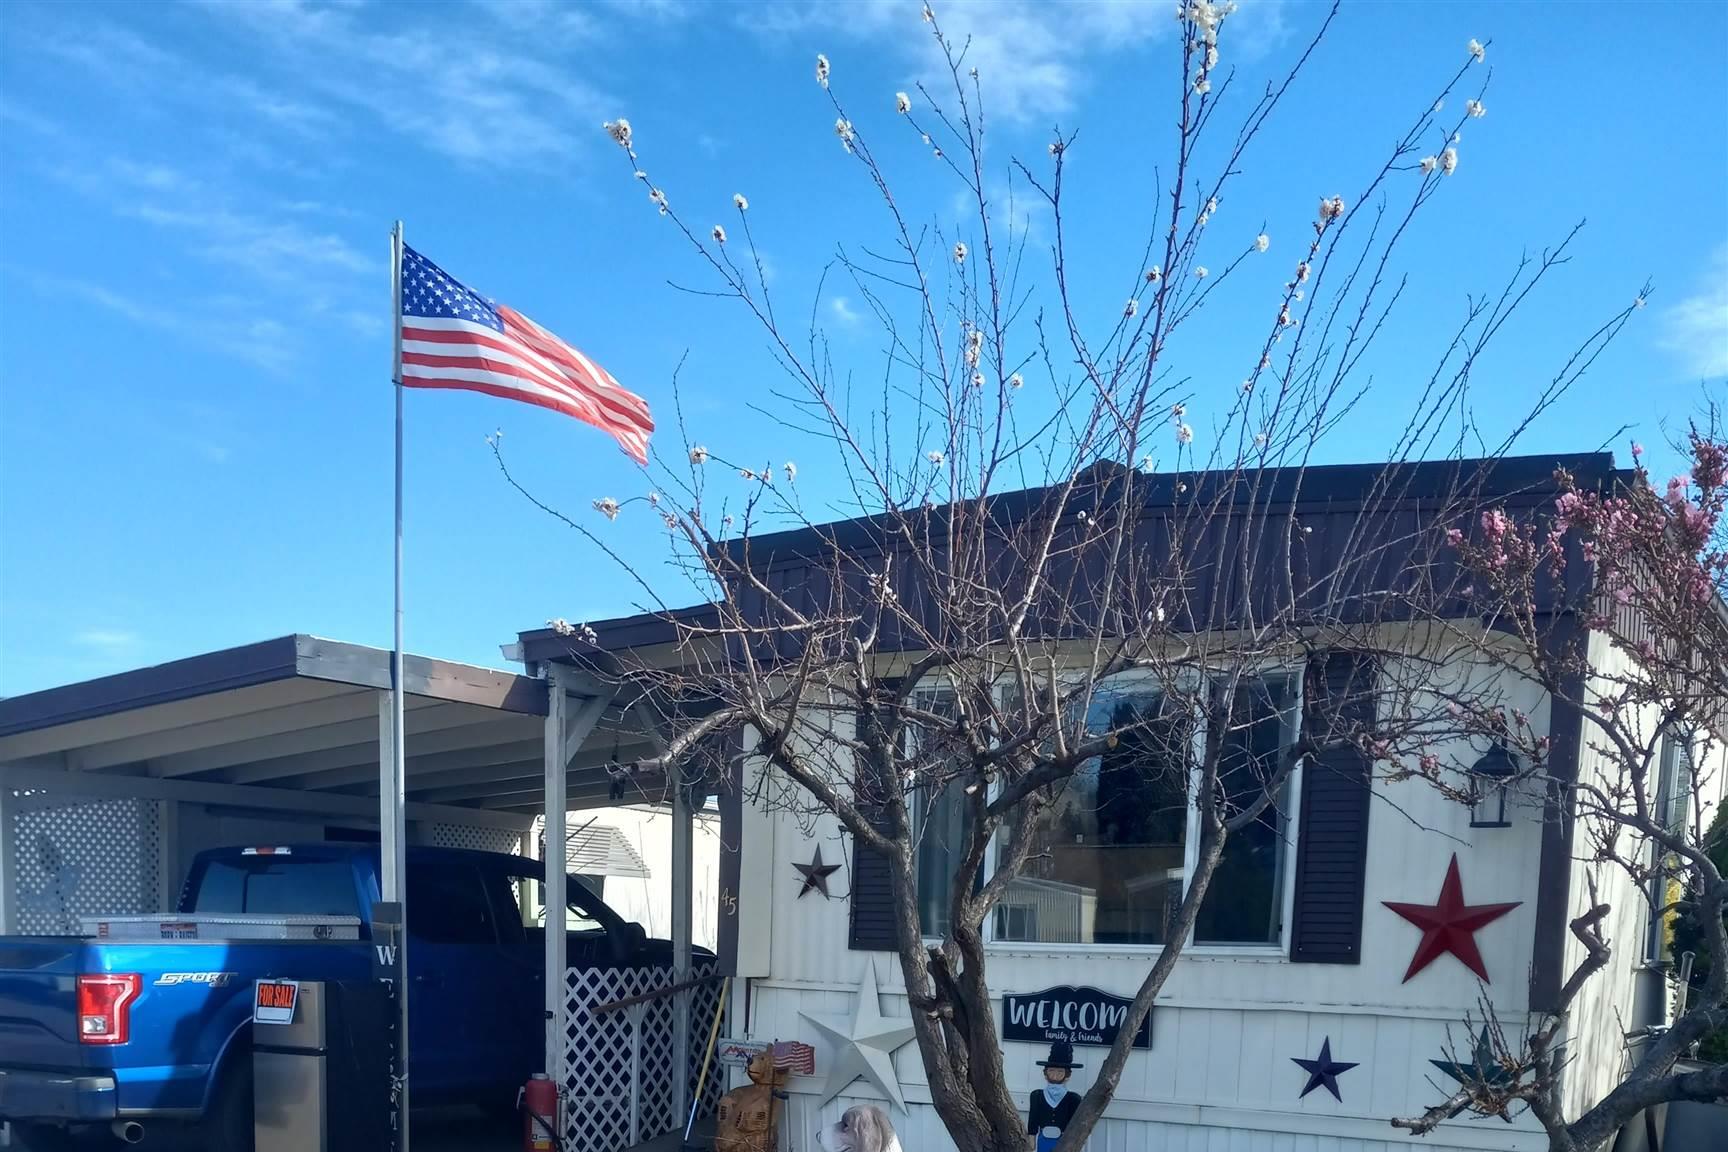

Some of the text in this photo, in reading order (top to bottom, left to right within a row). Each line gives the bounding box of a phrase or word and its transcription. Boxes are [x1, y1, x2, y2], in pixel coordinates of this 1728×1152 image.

[720, 887, 737, 916] 45
[153, 972, 239, 987] SPORT
[258, 984, 295, 1008] FOR SALE
[1009, 997, 1143, 1033] WELCOM
[1070, 1031, 1078, 1043] &
